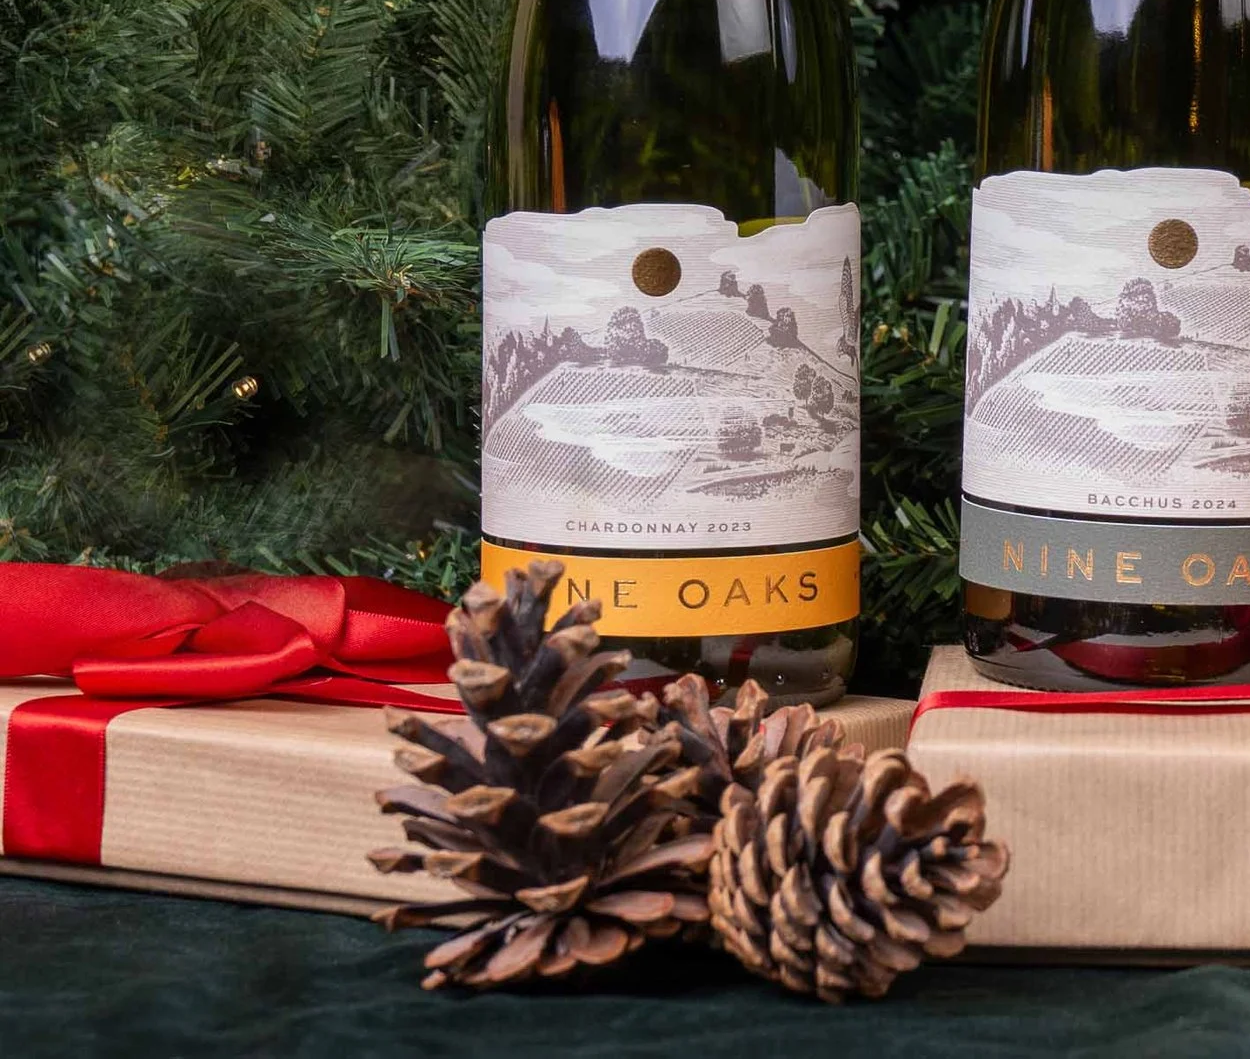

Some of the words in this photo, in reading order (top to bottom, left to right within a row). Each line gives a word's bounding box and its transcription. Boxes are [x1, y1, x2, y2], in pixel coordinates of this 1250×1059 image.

[1087, 493, 1183, 509] BACCHUS
[1191, 499, 1238, 510] 2024
[565, 520, 698, 534] CHARDONNAY
[706, 521, 753, 534] 2023
[1003, 538, 1143, 584] NINE
[566, 577, 639, 609] NE
[677, 571, 819, 610] OAKS
